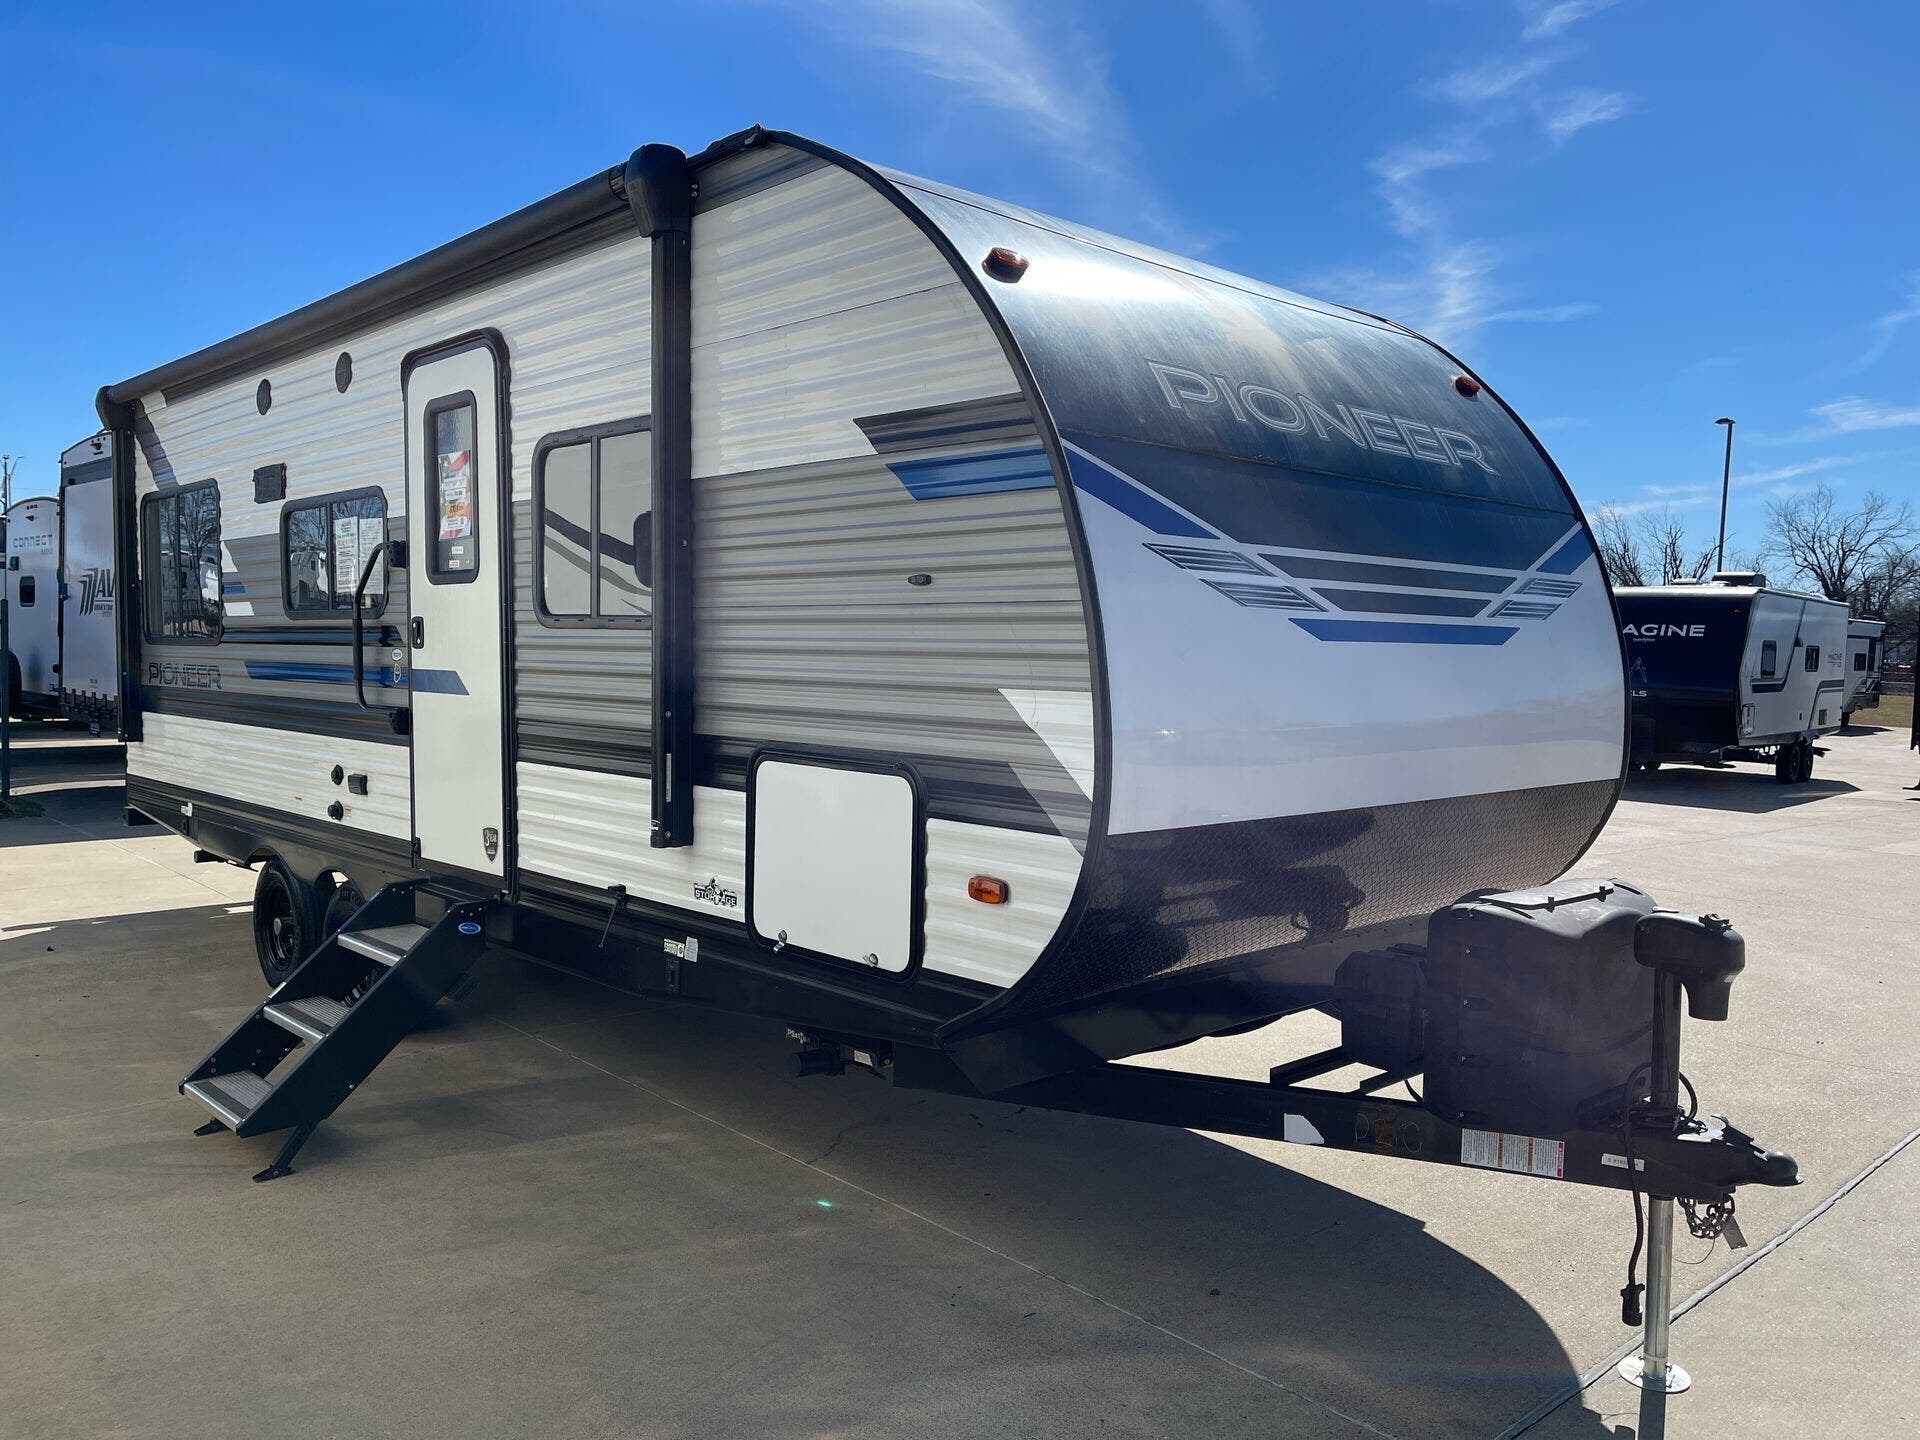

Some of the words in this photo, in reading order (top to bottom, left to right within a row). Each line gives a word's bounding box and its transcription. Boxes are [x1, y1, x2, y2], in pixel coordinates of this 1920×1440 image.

[1143, 357, 1498, 475] PIONEER
[13, 534, 53, 549] CONNECT
[148, 662, 223, 690] PIONEER
